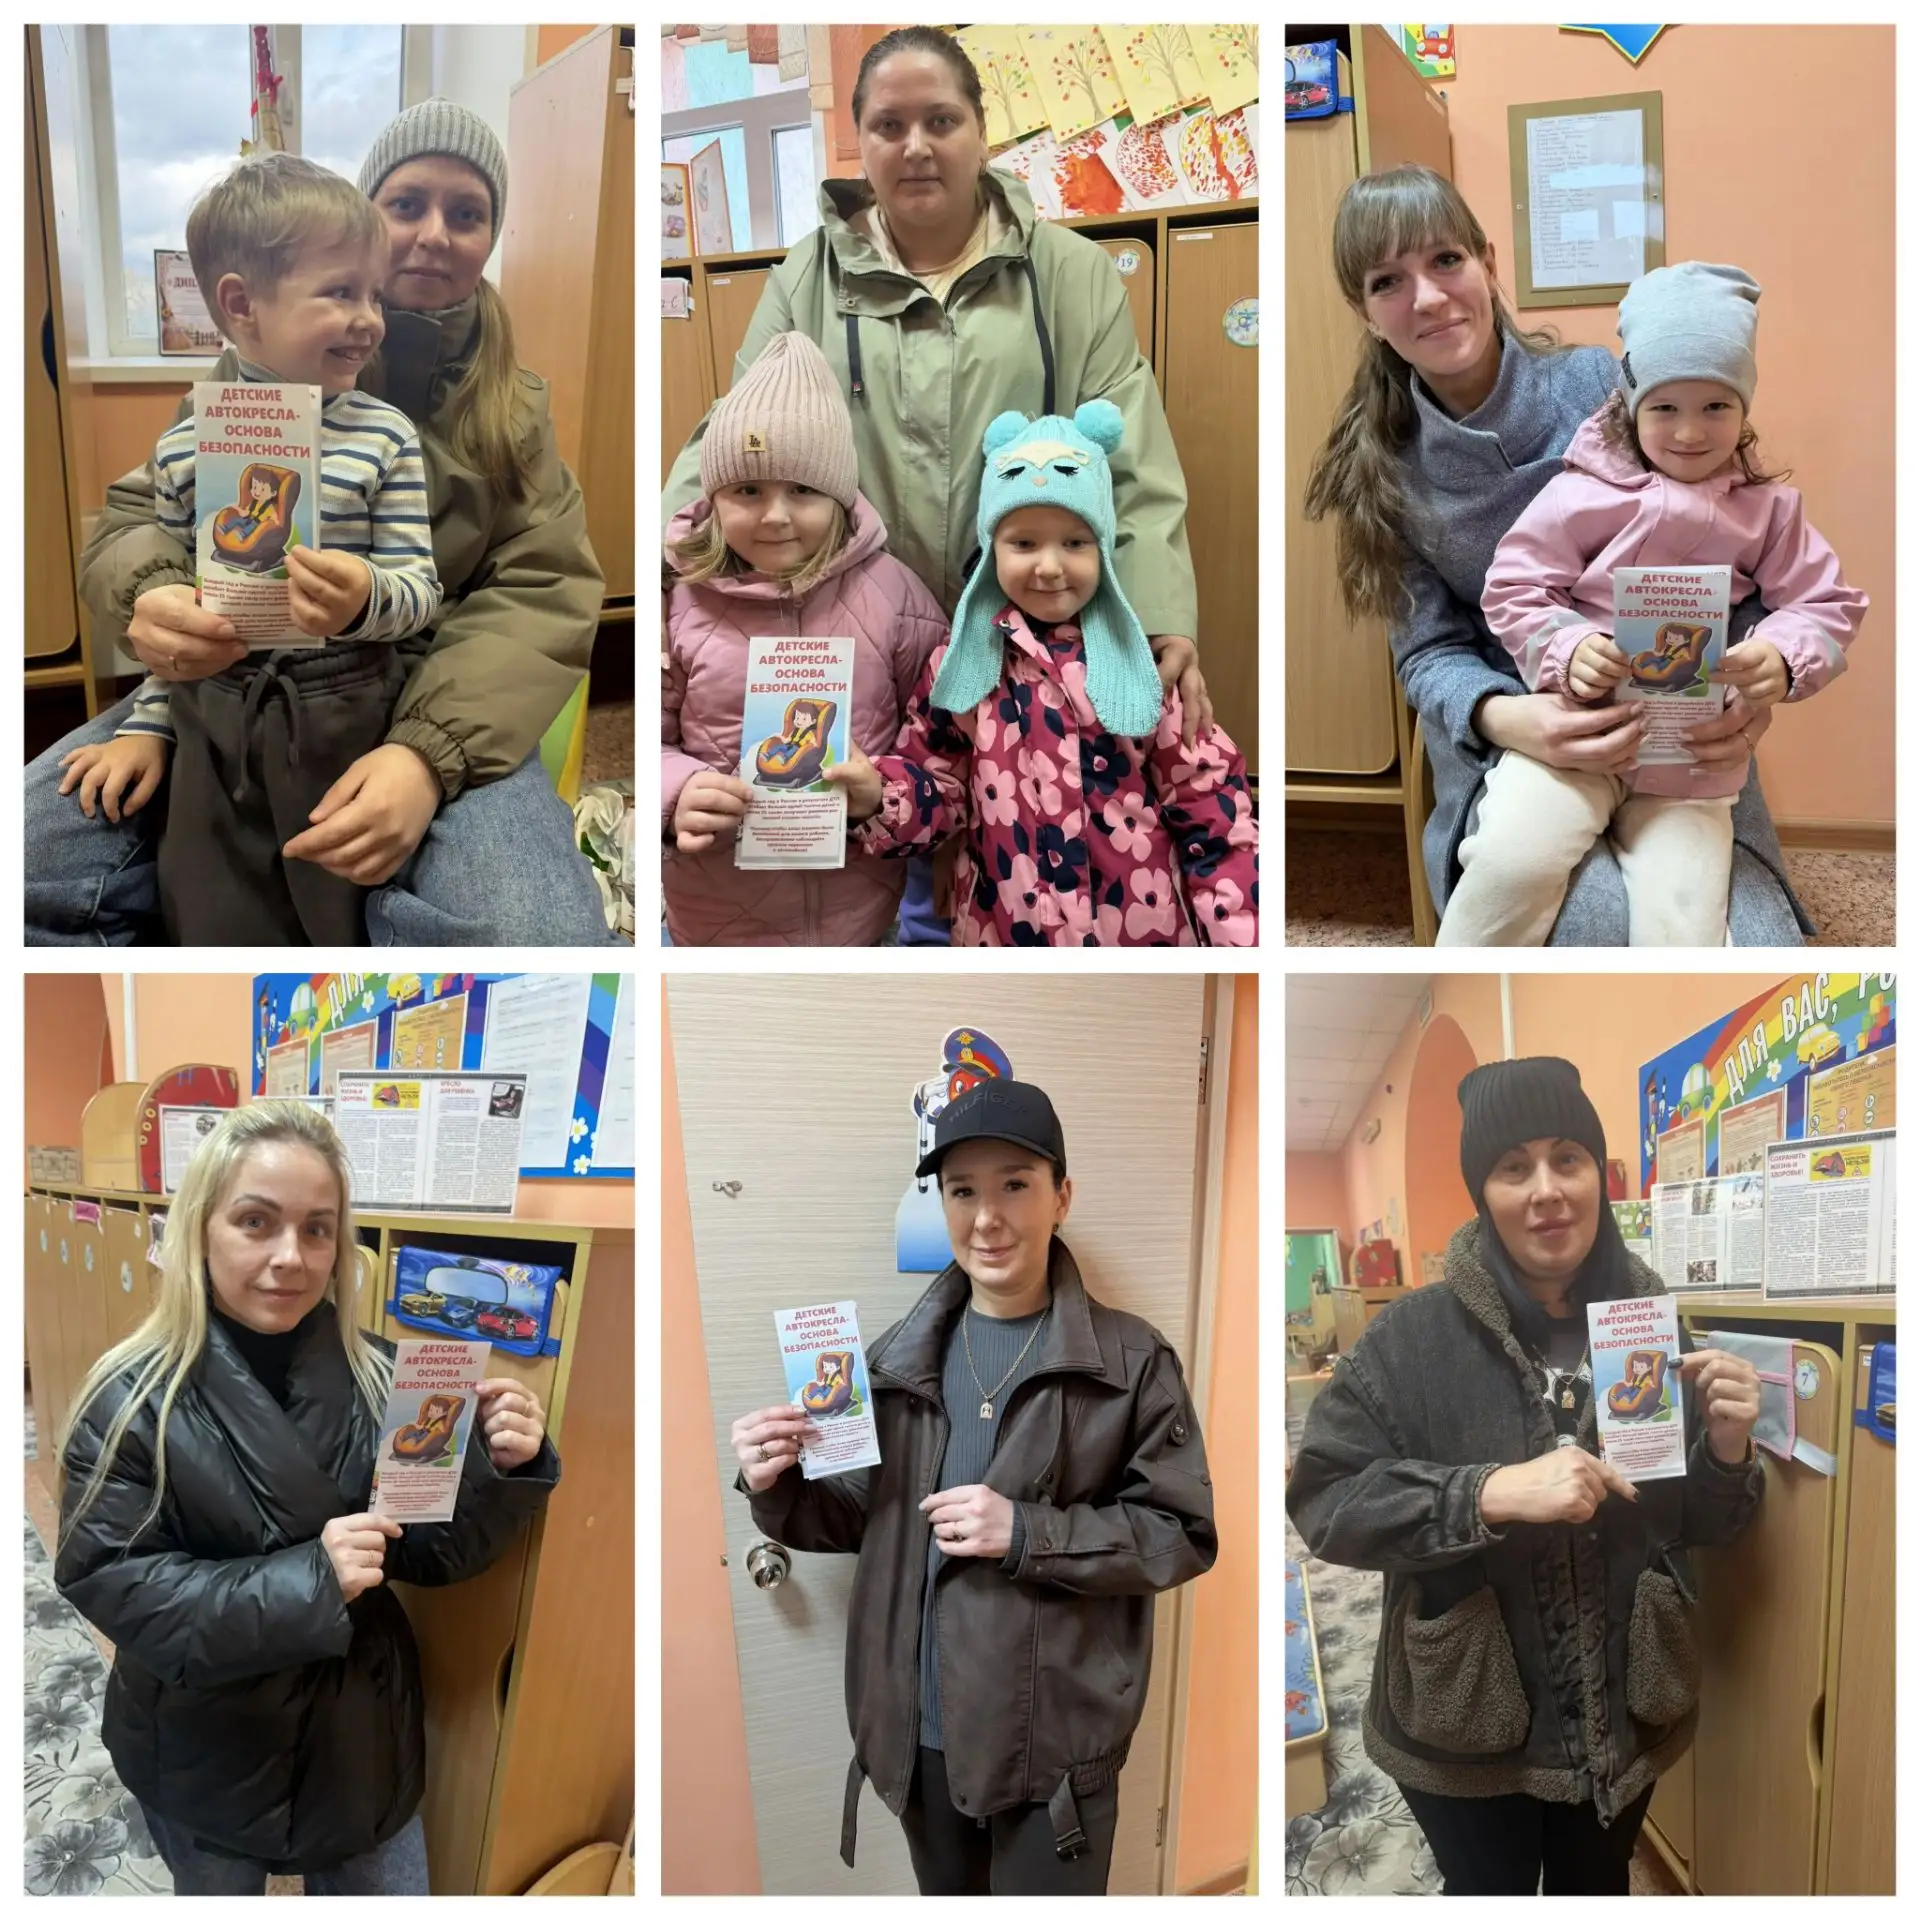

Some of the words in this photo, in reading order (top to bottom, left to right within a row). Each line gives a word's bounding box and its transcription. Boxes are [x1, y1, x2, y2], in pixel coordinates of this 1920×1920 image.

[1120, 257, 1133, 268] 19
[221, 388, 282, 402] ДЕТСКИЕ
[205, 406, 300, 421] АВТОКРЕСЛА-
[224, 424, 283, 438] ОСНОВА
[198, 441, 311, 458] БЕЗОПАСНОСТИ
[1641, 573, 1702, 584] ДЕТСКИЕ
[1643, 598, 1698, 607] ОСНОВА
[1618, 609, 1723, 619] БЕЗОПАСНОСТИ
[775, 641, 830, 652] ДЕТСКИЕ
[759, 655, 843, 665] АВТОКРЕСЛА-
[775, 669, 825, 678] ОСНОВА
[750, 682, 847, 693] БЕЗОПАСНОСТИ
[1724, 1020, 1768, 1106] ДЛЯ
[1781, 973, 1838, 1043] ВАС,
[795, 1306, 837, 1320] ДЕТСКИЕ
[1608, 1300, 1654, 1315] ДЕТСКИЕ
[1597, 1311, 1666, 1327] АВТОКРЕСЛА-
[800, 1328, 839, 1340] ОСНОВА
[1611, 1324, 1654, 1336] ОСНОВА
[784, 1336, 858, 1353] БЕЗОПАСНОСТИ
[1593, 1334, 1674, 1350] БЕЗОПАСНОСТИ
[419, 1344, 469, 1354] ДЕТСКИЕ
[416, 1369, 460, 1377] ОСНОВА
[1801, 1372, 1809, 1386] 7
[394, 1381, 477, 1390] БЕЗОПАСНОСТИ
